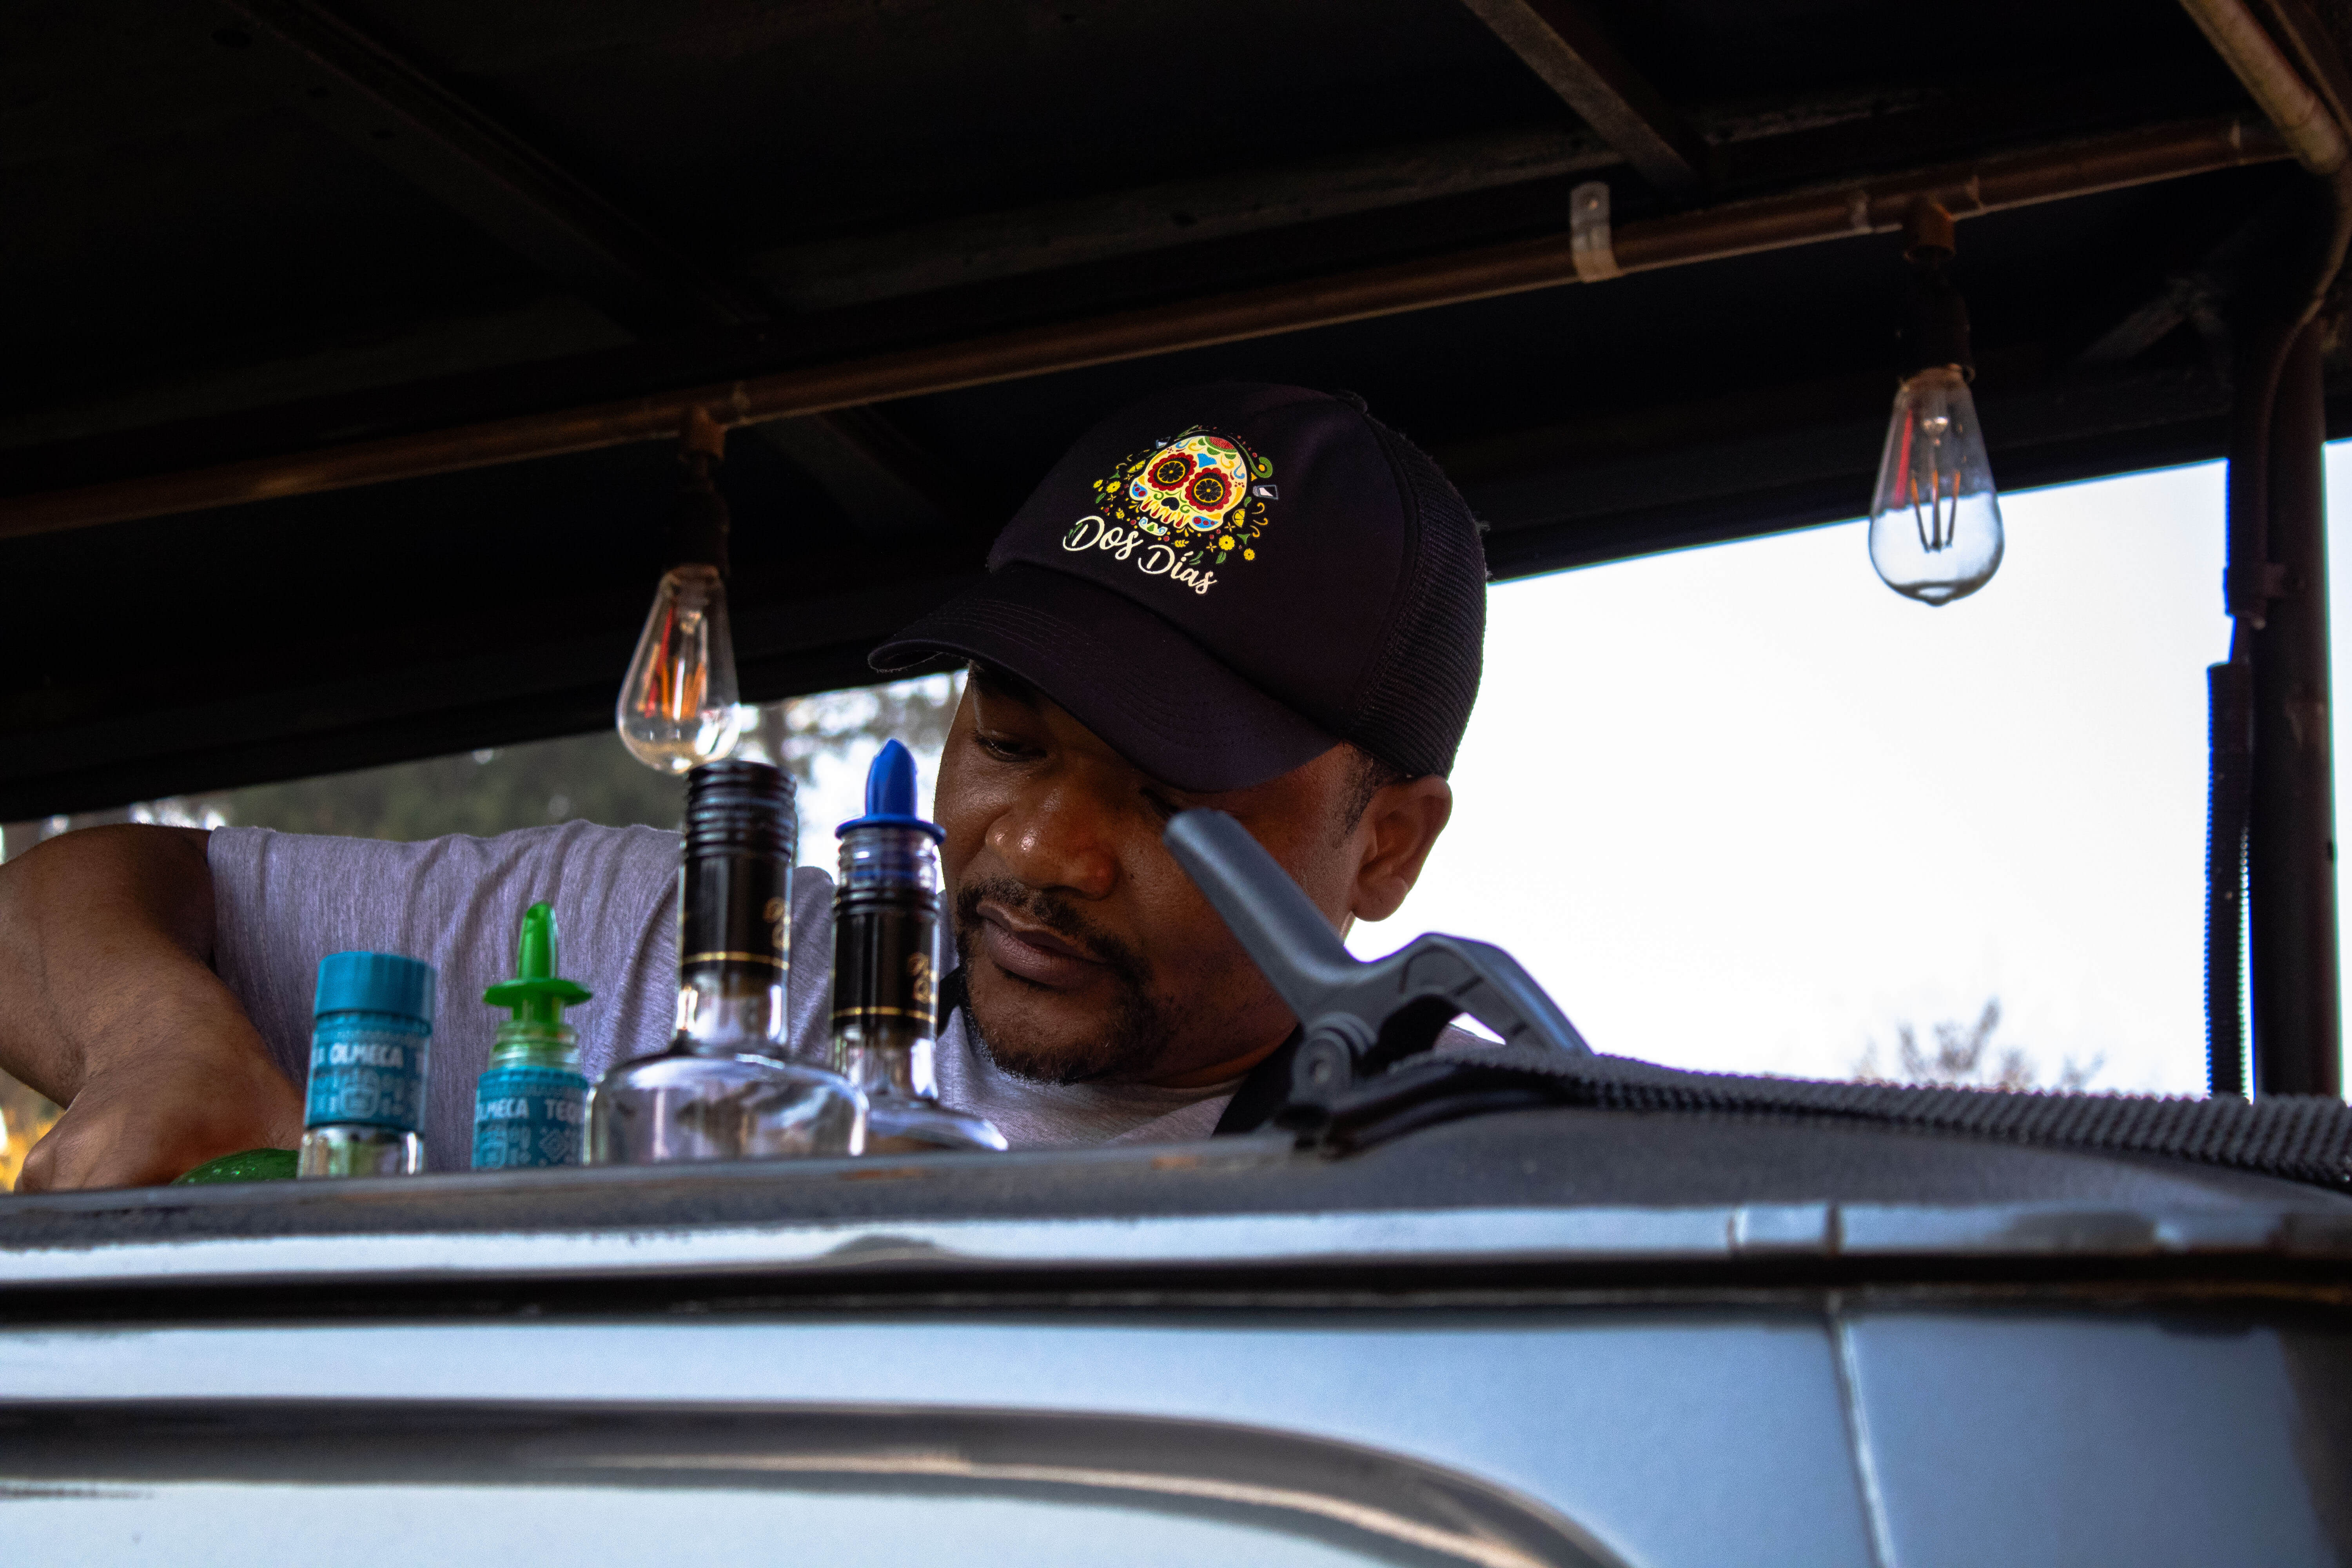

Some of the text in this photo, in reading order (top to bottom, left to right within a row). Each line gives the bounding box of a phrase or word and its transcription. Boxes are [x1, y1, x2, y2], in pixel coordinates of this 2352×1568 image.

[1063, 515, 1218, 594] Dos Días
[329, 1042, 404, 1069] OLMECA
[475, 1097, 530, 1120] LMECA
